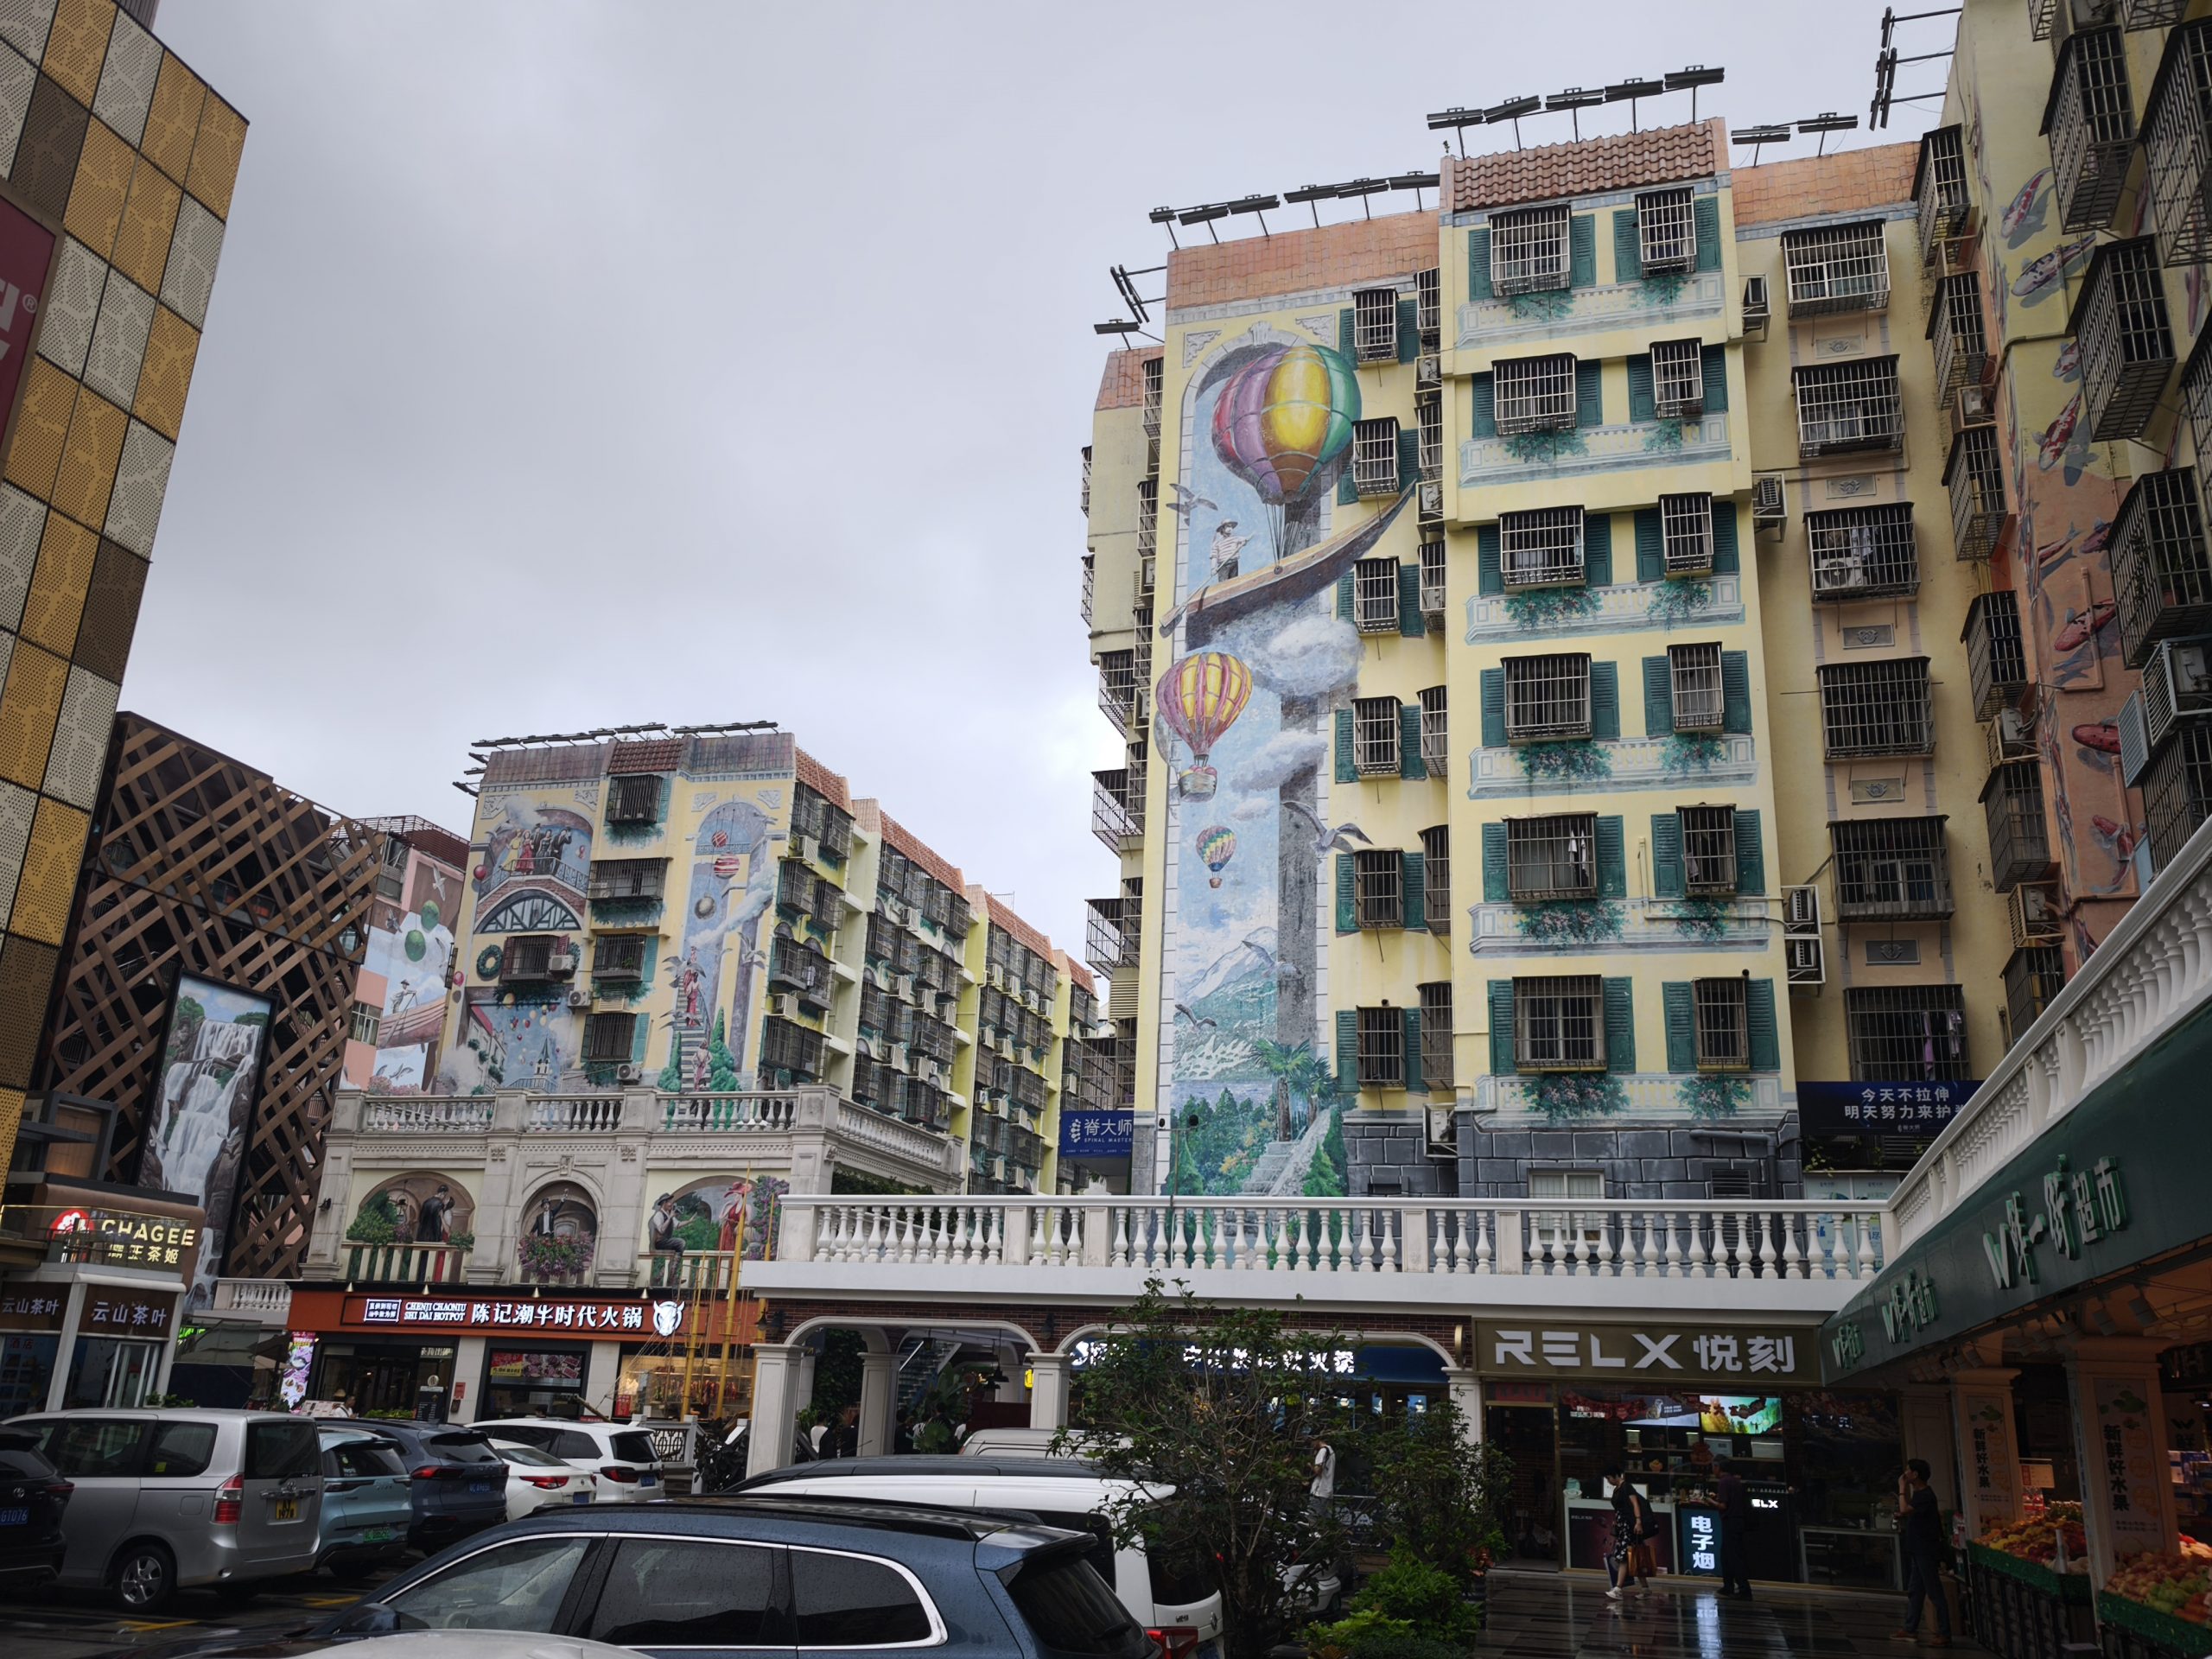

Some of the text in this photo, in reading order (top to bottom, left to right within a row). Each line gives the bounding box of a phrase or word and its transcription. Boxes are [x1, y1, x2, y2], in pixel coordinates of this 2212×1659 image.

[1861, 1087, 1949, 1103] 今天不拉伸
[1084, 1118, 1133, 1136] 脊大师
[101, 1219, 196, 1247] CHAGEE
[2, 1298, 60, 1316] 云山茶叶
[92, 1301, 167, 1328] 云山茶叶
[404, 1312, 418, 1320] SHI
[471, 1303, 643, 1329] 陈记潮牛时代火锅
[1496, 1331, 1683, 1370] RELX
[1694, 1334, 1796, 1374] 悦刻
[1974, 1427, 1991, 1489] 新鲜好水果
[2104, 1424, 2130, 1512] 新鲜好水果
[1690, 1515, 1715, 1570] 电子烟
